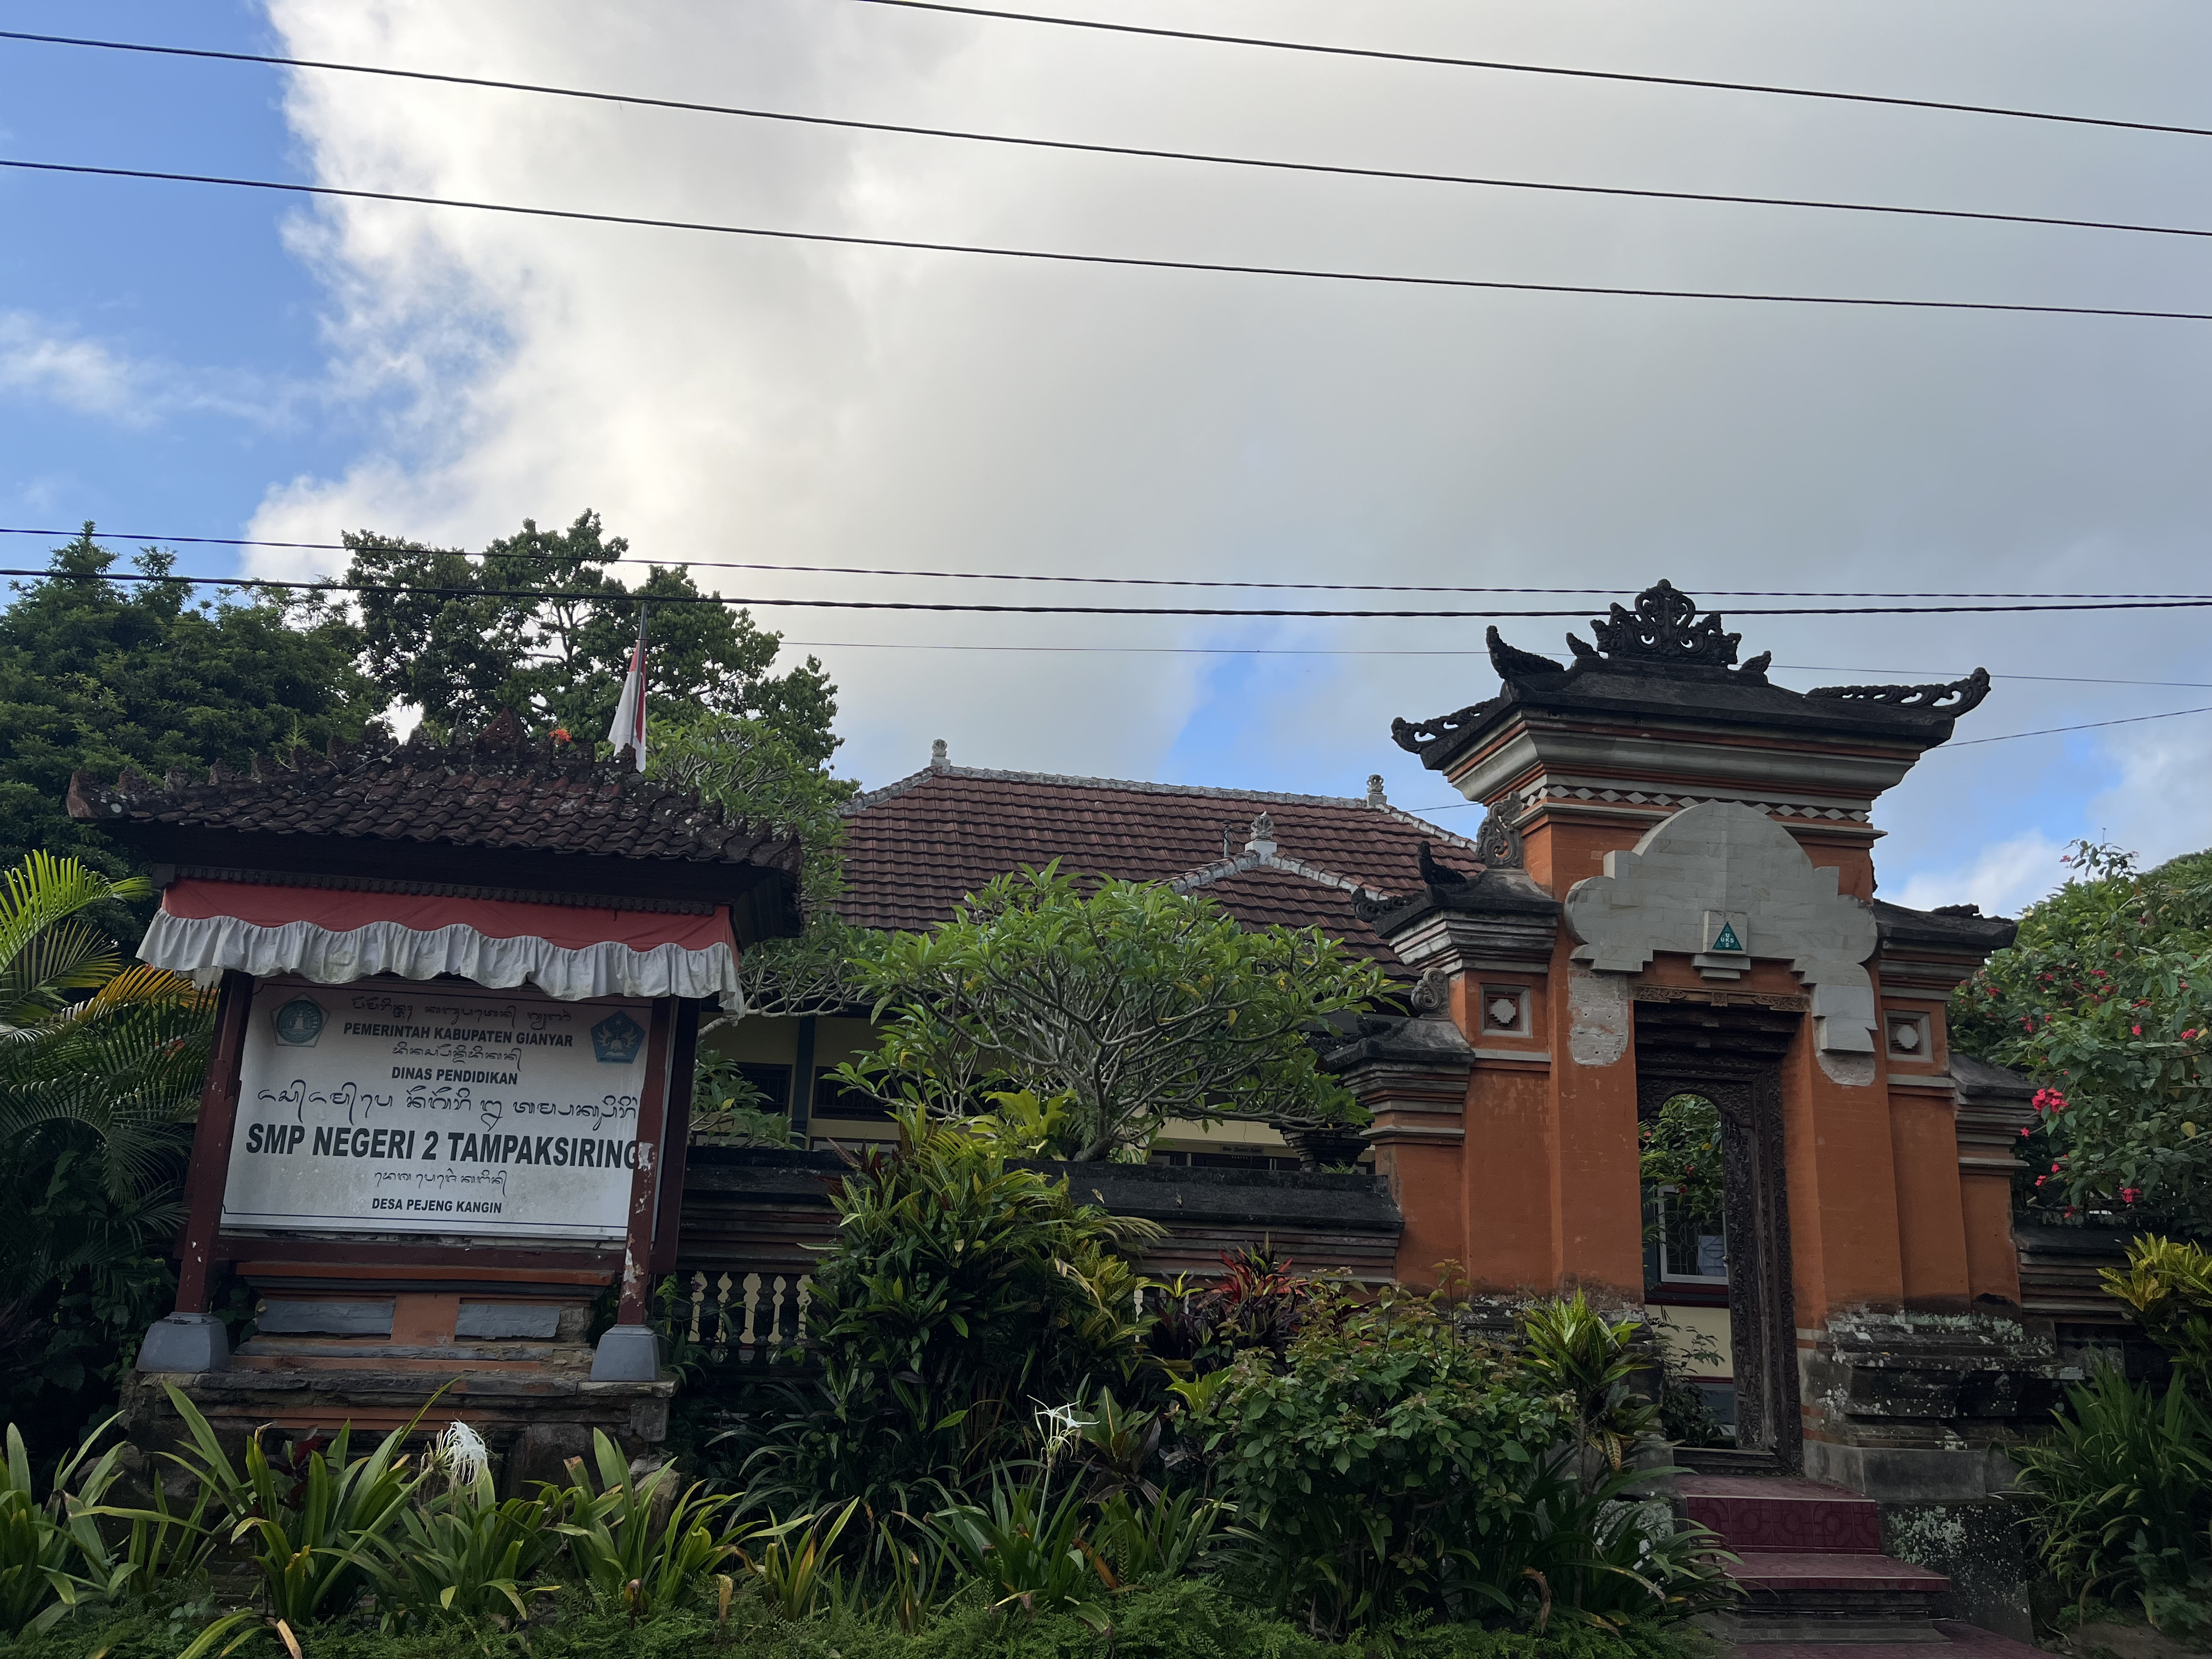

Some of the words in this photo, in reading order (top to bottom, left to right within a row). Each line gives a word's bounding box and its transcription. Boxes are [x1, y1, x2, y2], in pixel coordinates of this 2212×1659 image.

[343, 1022, 431, 1039] PEMERINTAH
[433, 1028, 513, 1043] KABUPATEN
[516, 1032, 573, 1047] GIANYAR
[391, 1066, 432, 1080] DINAS
[436, 1068, 518, 1085] PENDIDIKAN
[246, 1122, 305, 1155] SMP
[312, 1126, 415, 1159] NEGERI
[421, 1131, 439, 1160] 2
[447, 1132, 637, 1169] TAMPAKSIRING
[371, 1198, 403, 1210] DESA
[406, 1199, 453, 1212] PEJENG
[455, 1200, 502, 1214] KANGIN
